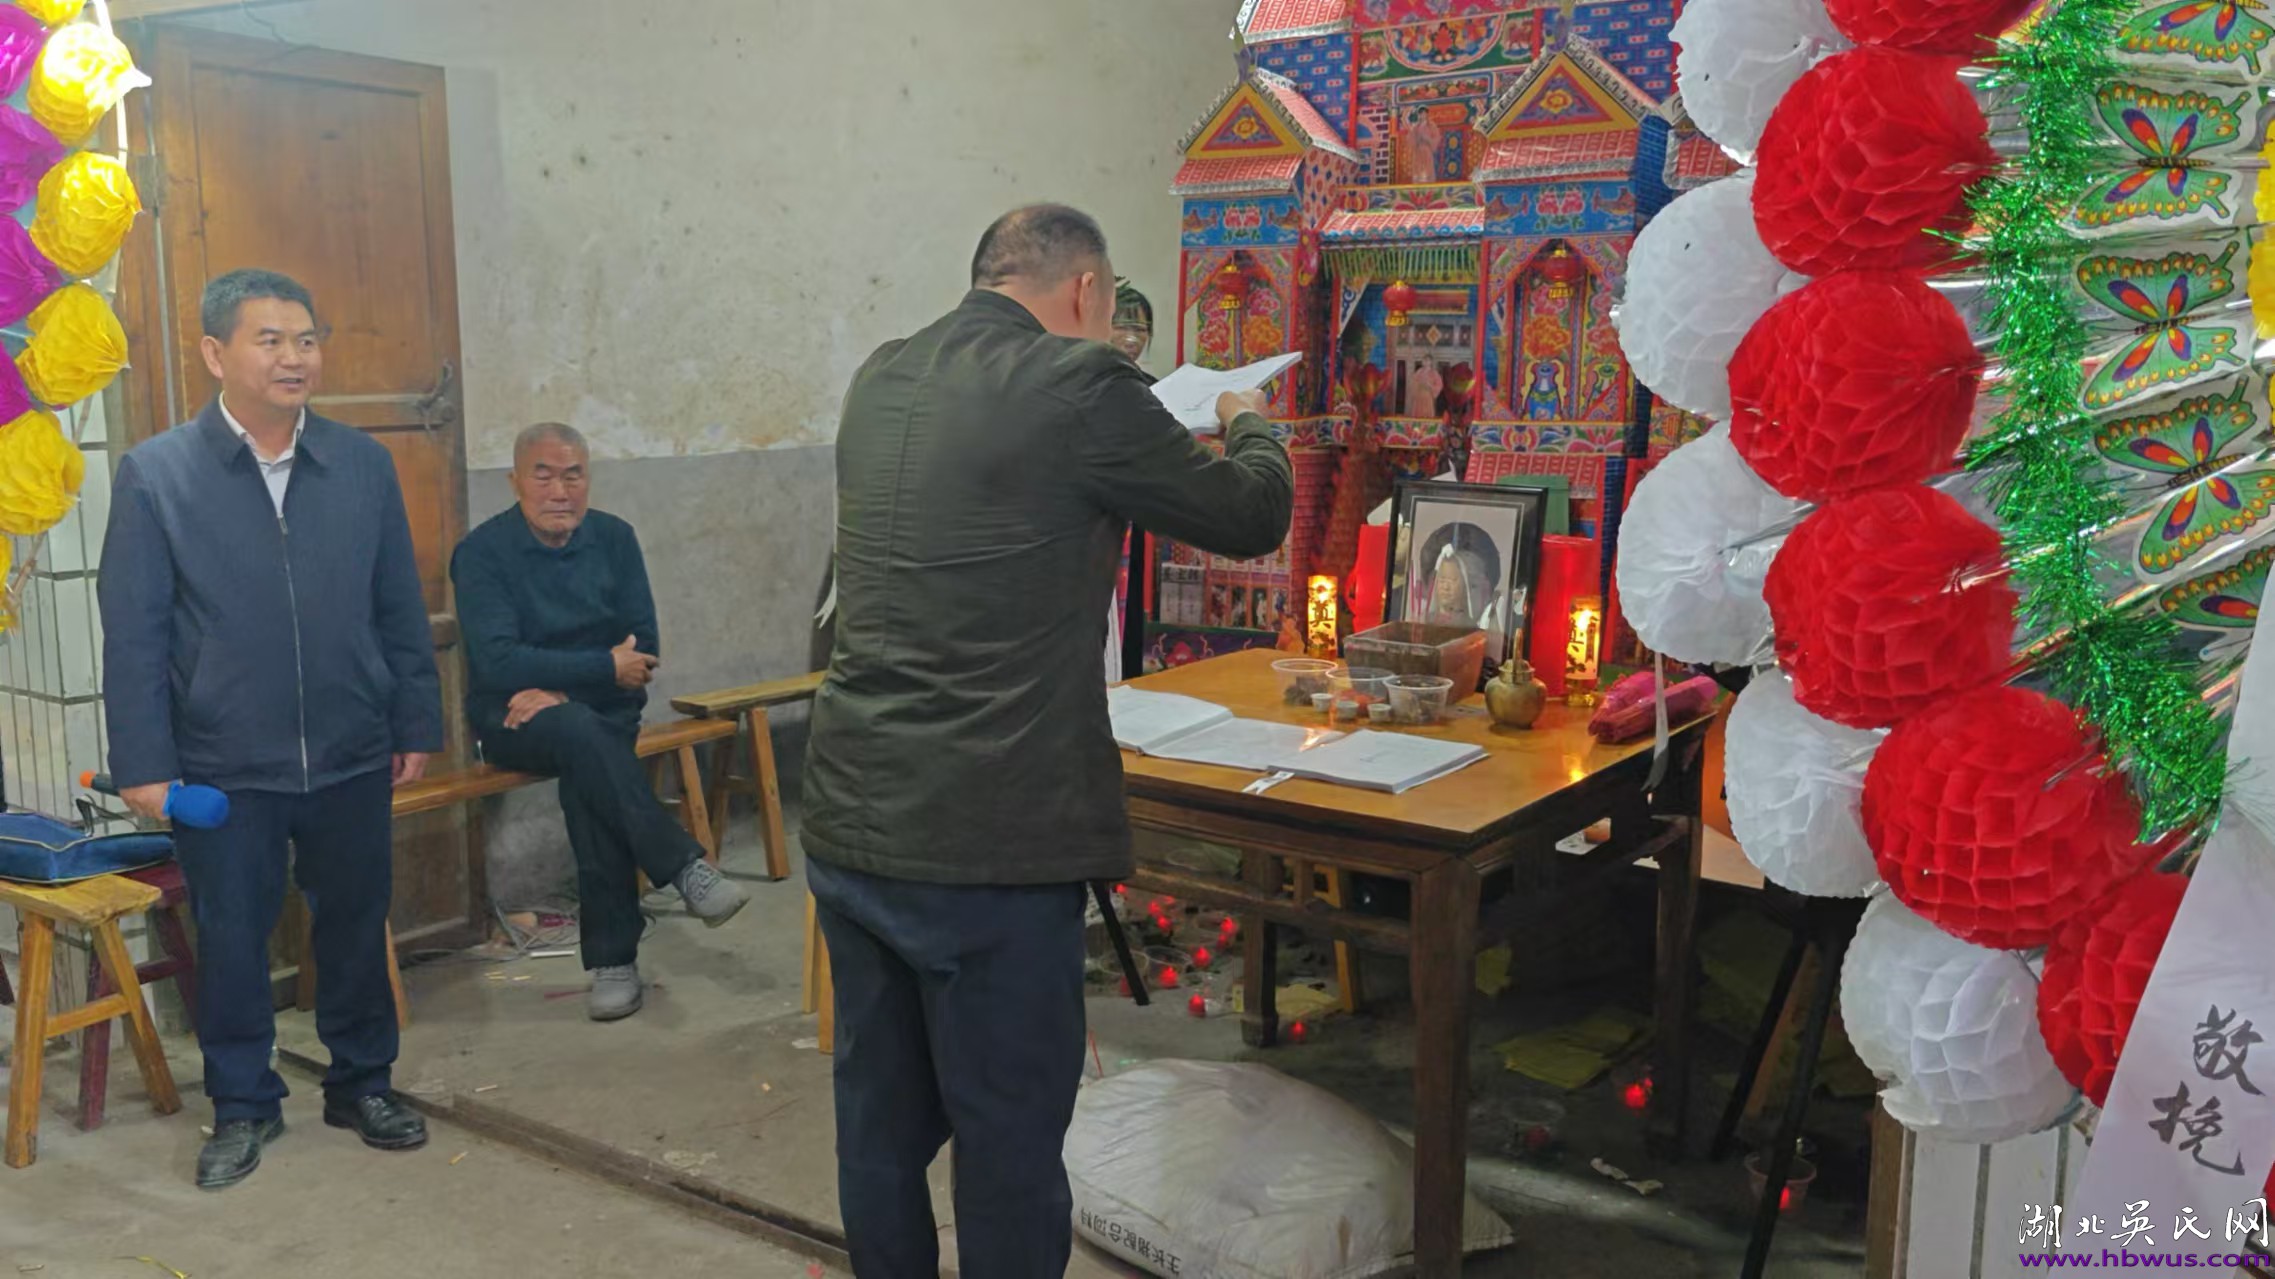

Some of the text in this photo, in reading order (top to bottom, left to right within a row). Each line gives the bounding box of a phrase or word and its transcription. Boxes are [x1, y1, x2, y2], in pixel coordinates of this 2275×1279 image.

[2148, 1004, 2266, 1176] 敬挽
[1081, 1207, 1181, 1275] 生长猪配合饲料
